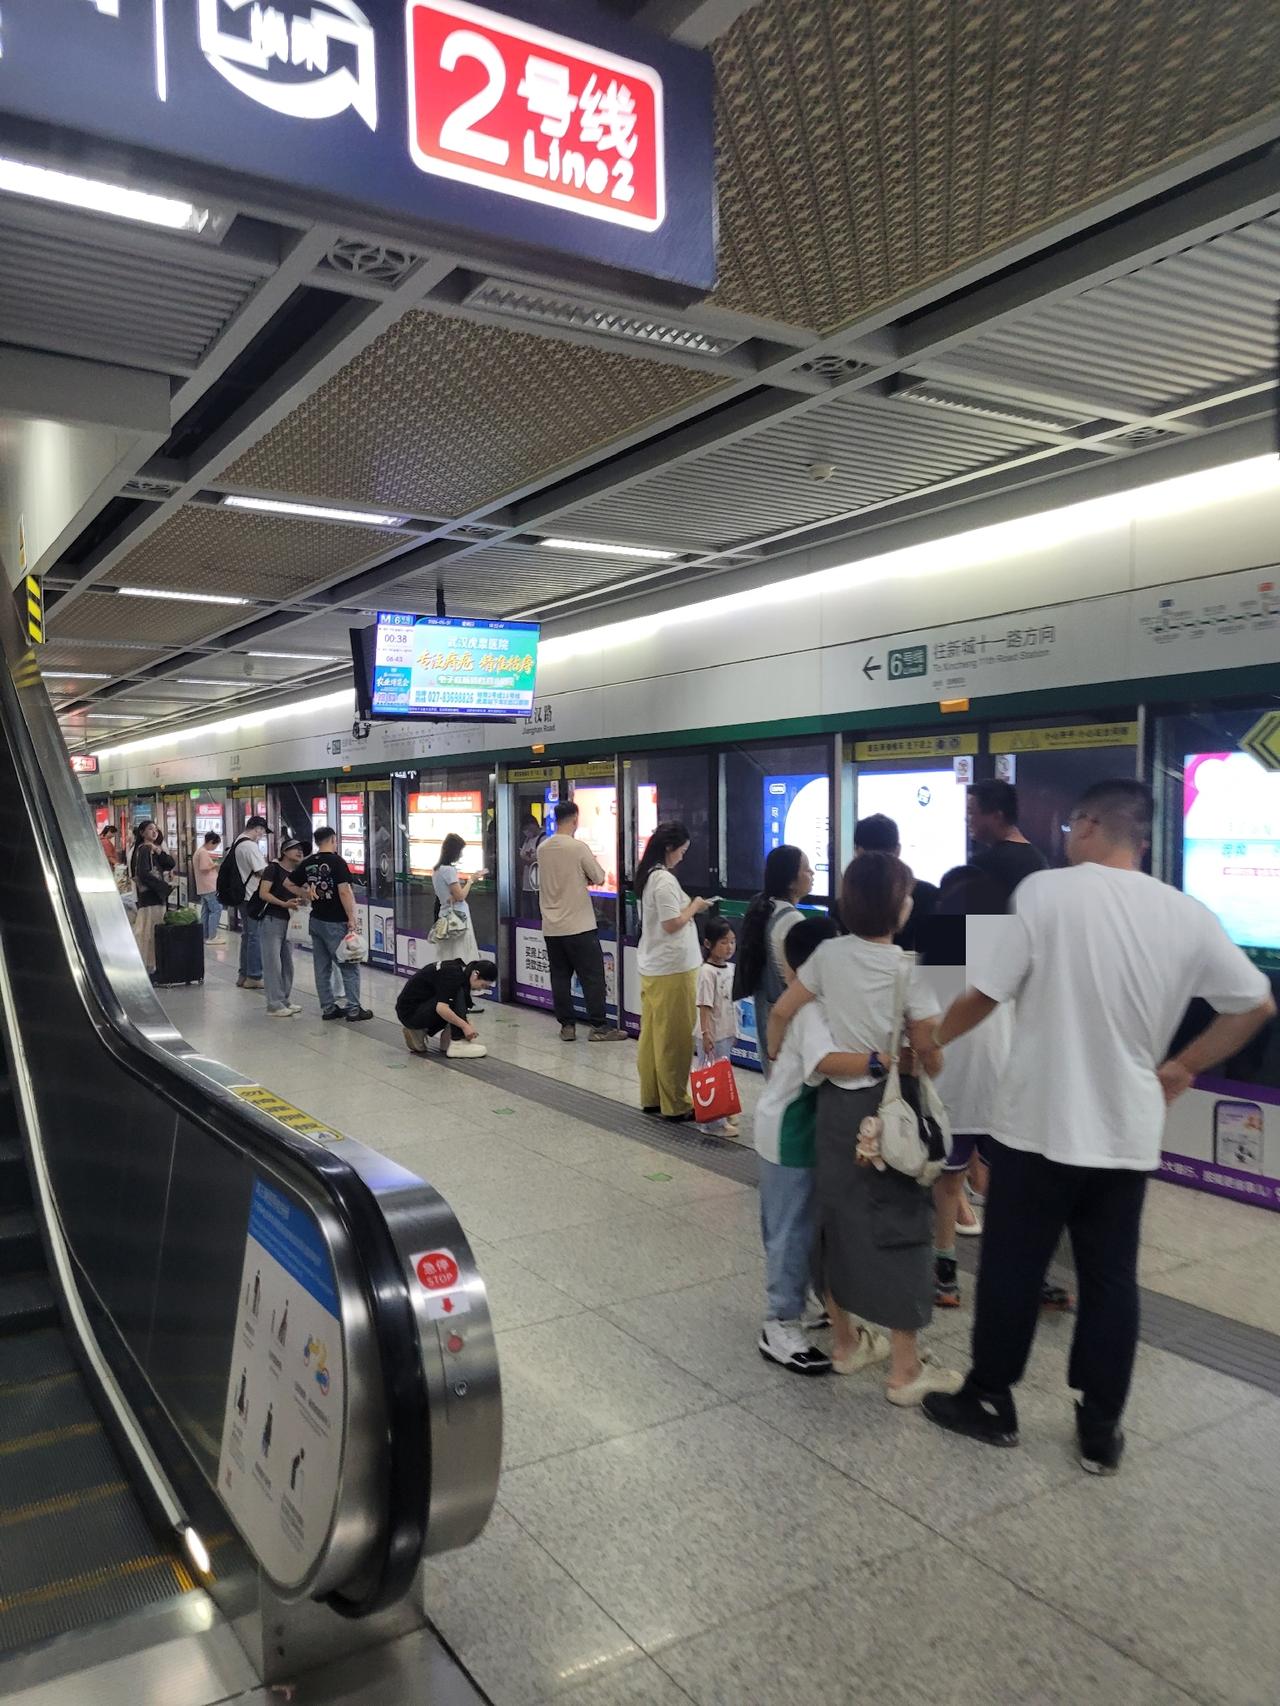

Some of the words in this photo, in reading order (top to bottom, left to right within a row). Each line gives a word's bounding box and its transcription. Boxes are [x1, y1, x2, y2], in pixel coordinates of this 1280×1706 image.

[610, 159, 635, 202] 2
[384, 634, 408, 644] 00:38
[935, 625, 1056, 659] 往新城十一路方向
[422, 1258, 450, 1276] 急停
[426, 1271, 454, 1287] STOP
